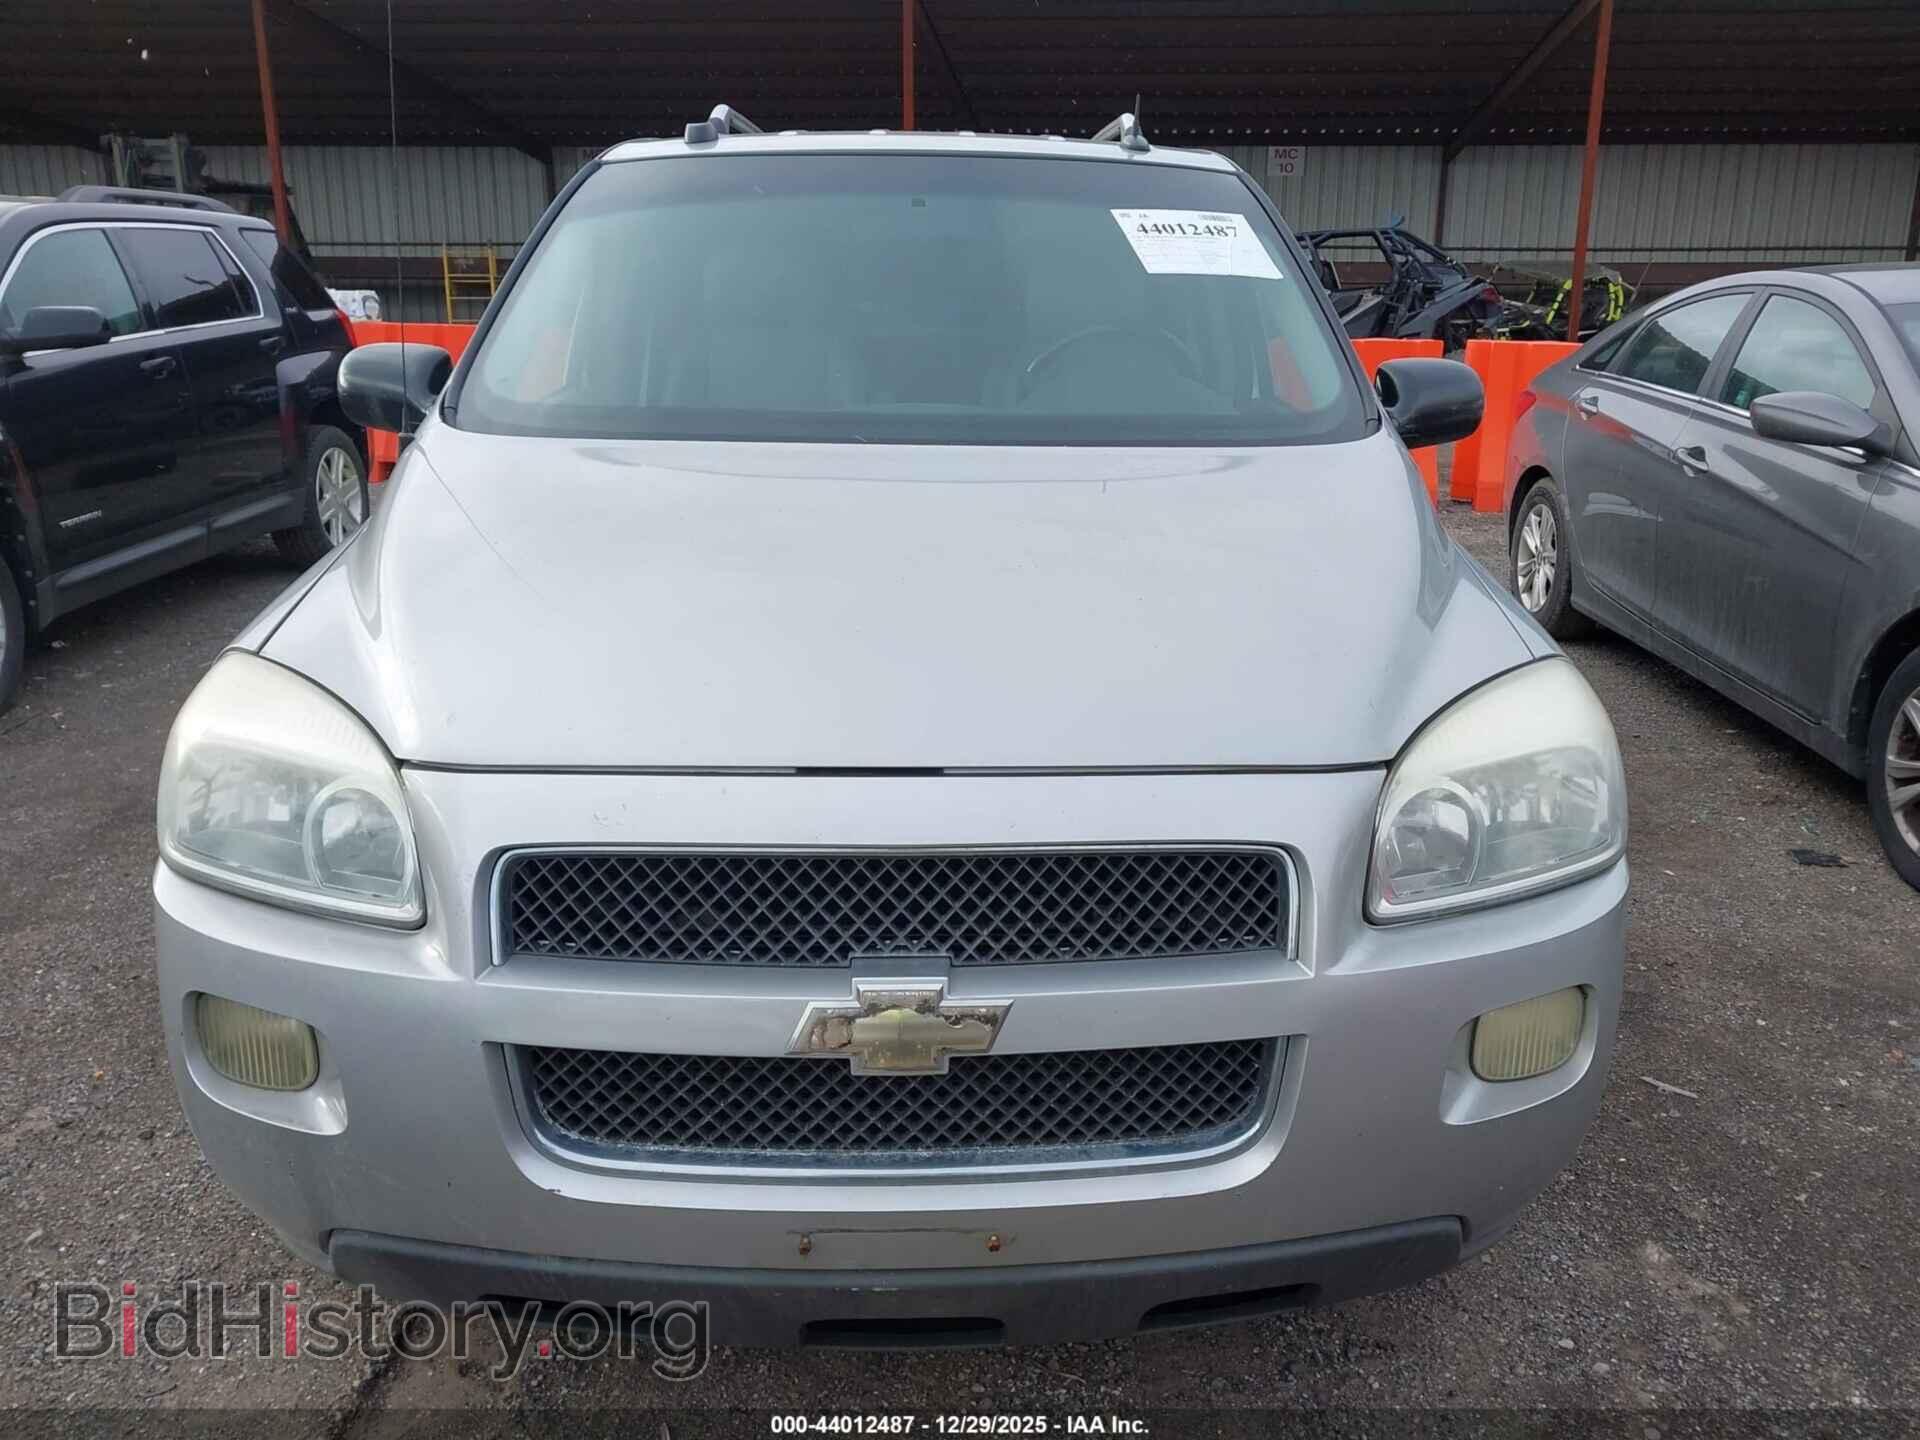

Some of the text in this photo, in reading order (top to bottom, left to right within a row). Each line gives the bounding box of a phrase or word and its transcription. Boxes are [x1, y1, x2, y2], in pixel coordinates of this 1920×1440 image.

[1274, 148, 1299, 160] MC
[1279, 162, 1295, 174] 10
[1136, 223, 1239, 238] 44012487
